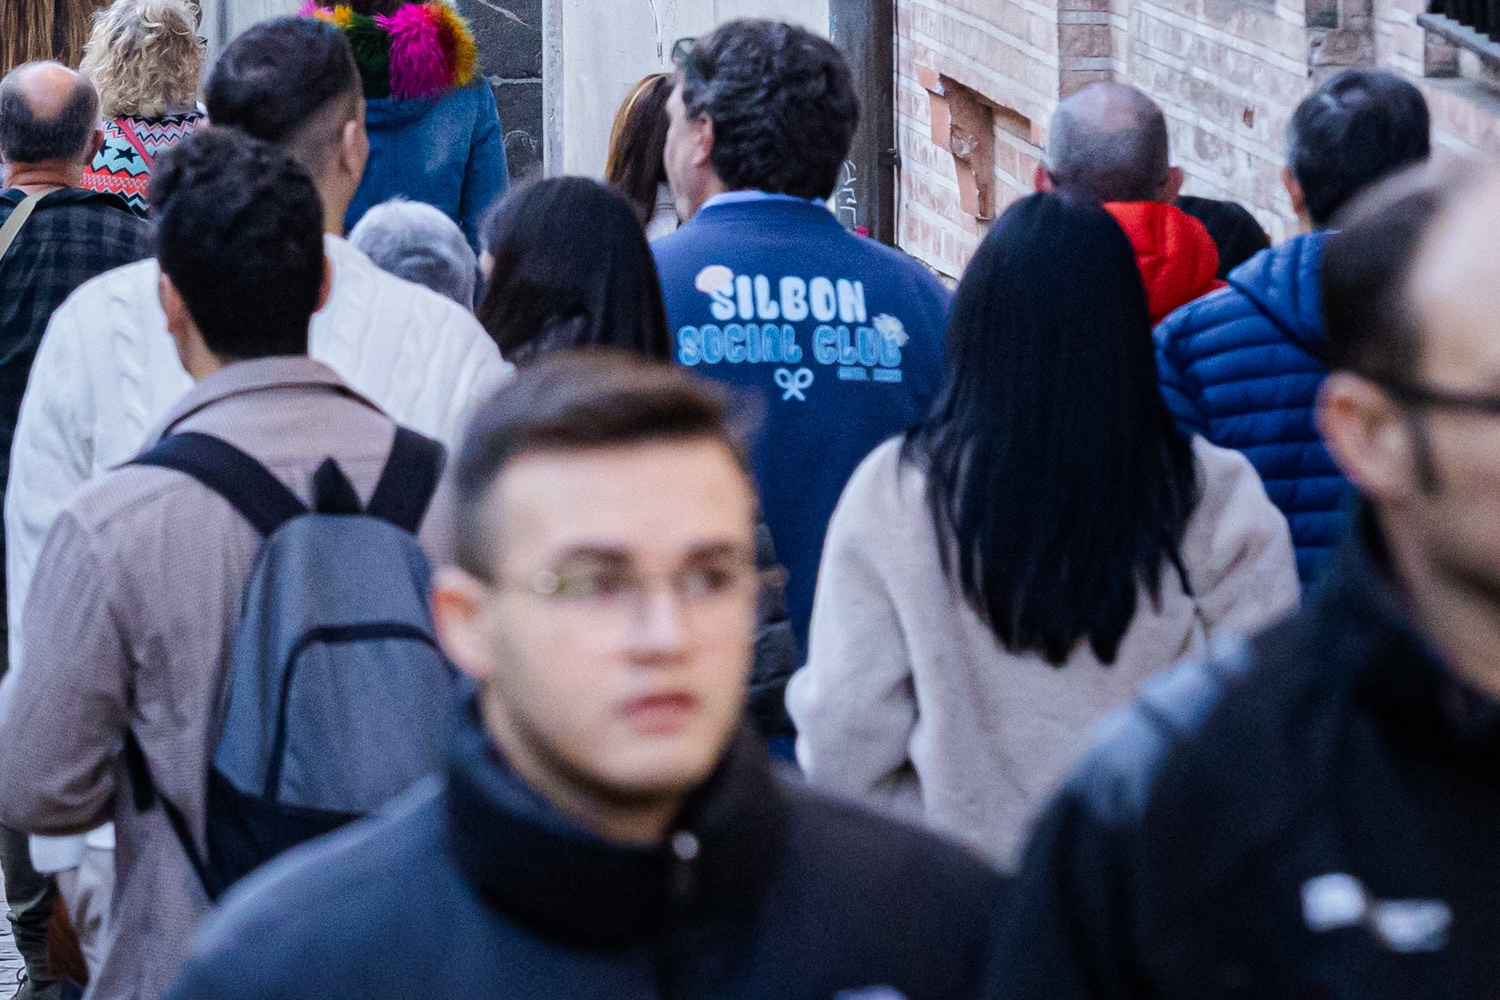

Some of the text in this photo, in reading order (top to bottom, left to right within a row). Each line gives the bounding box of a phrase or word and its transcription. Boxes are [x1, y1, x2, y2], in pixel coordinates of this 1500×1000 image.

[710, 274, 867, 323] SILBON
[677, 323, 902, 368] SOCIAL CLUB
